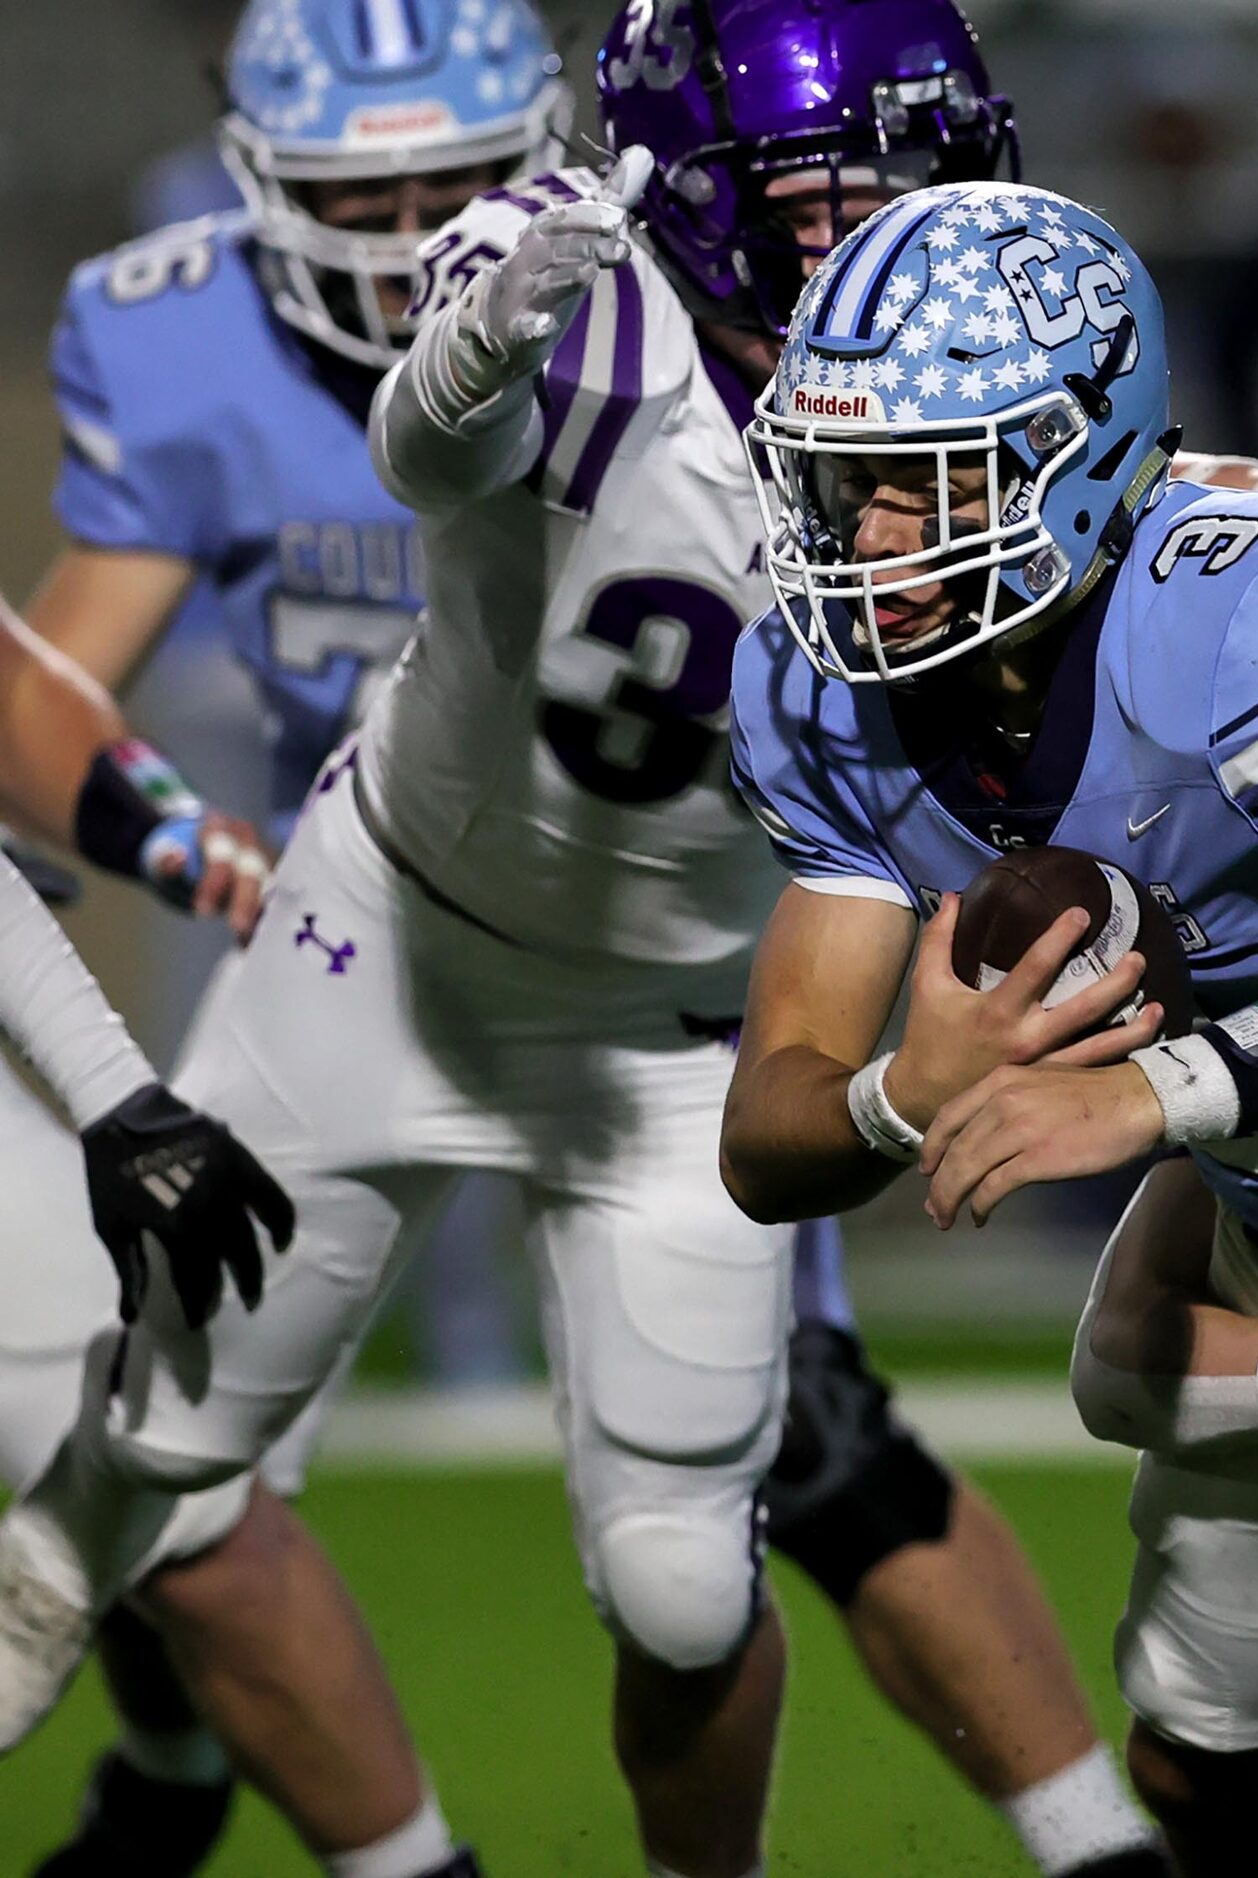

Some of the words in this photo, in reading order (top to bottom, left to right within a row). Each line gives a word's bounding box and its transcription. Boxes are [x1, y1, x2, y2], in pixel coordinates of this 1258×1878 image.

[608, 0, 696, 91] 35
[996, 233, 1141, 378] CS
[795, 389, 868, 418] Riddell
